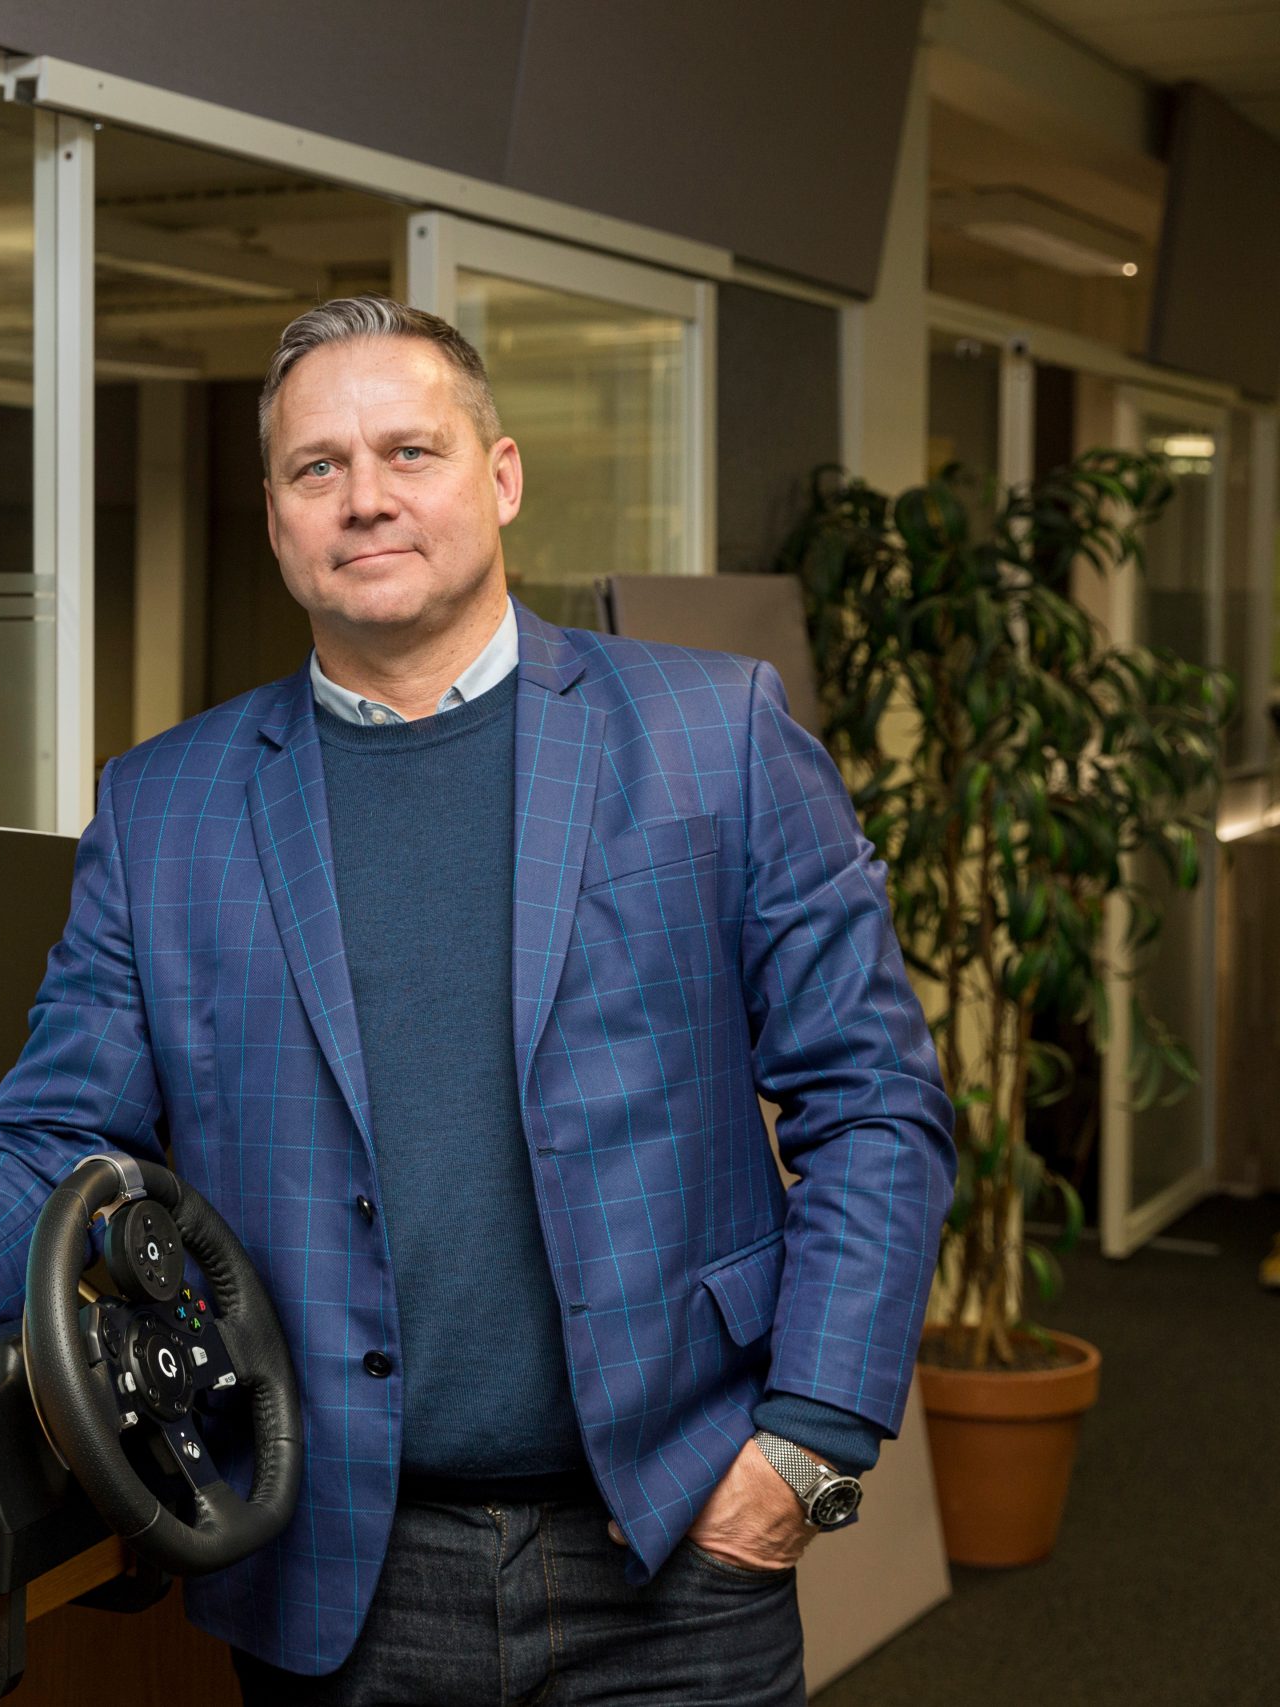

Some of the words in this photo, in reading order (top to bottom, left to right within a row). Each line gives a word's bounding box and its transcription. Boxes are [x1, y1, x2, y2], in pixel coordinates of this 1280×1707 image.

[183, 1289, 191, 1300] Y
[198, 1299, 206, 1311] B
[178, 1306, 186, 1318] X
[193, 1317, 201, 1329] A
